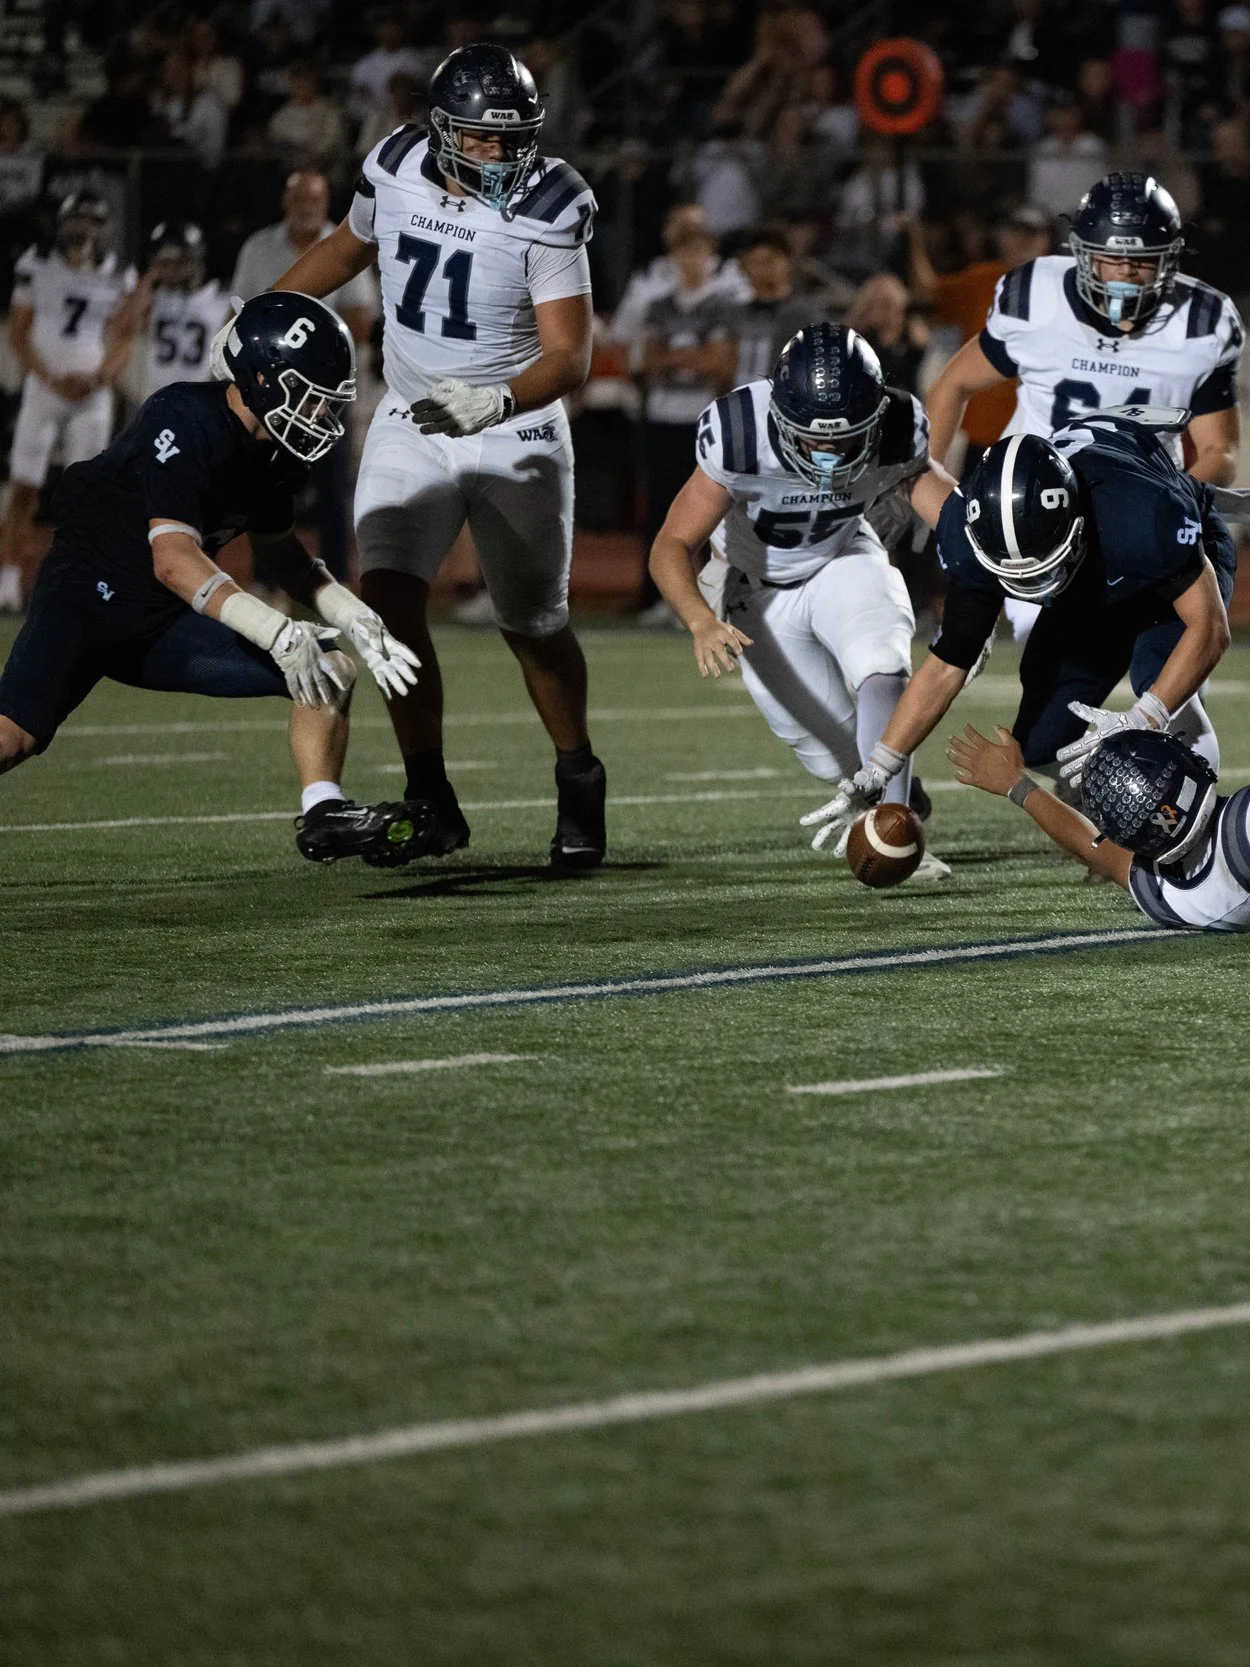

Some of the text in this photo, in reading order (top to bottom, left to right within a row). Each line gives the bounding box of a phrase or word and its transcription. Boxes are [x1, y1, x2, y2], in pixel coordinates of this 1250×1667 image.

[409, 214, 477, 243] CHAMPION
[395, 231, 477, 341] 71
[64, 297, 88, 336] 7
[155, 319, 206, 366] 53
[284, 317, 316, 350] 6
[1071, 357, 1140, 378] CHAMPION
[154, 428, 181, 464] SV
[781, 493, 852, 505] CHAMPION
[1176, 517, 1201, 546] SV
